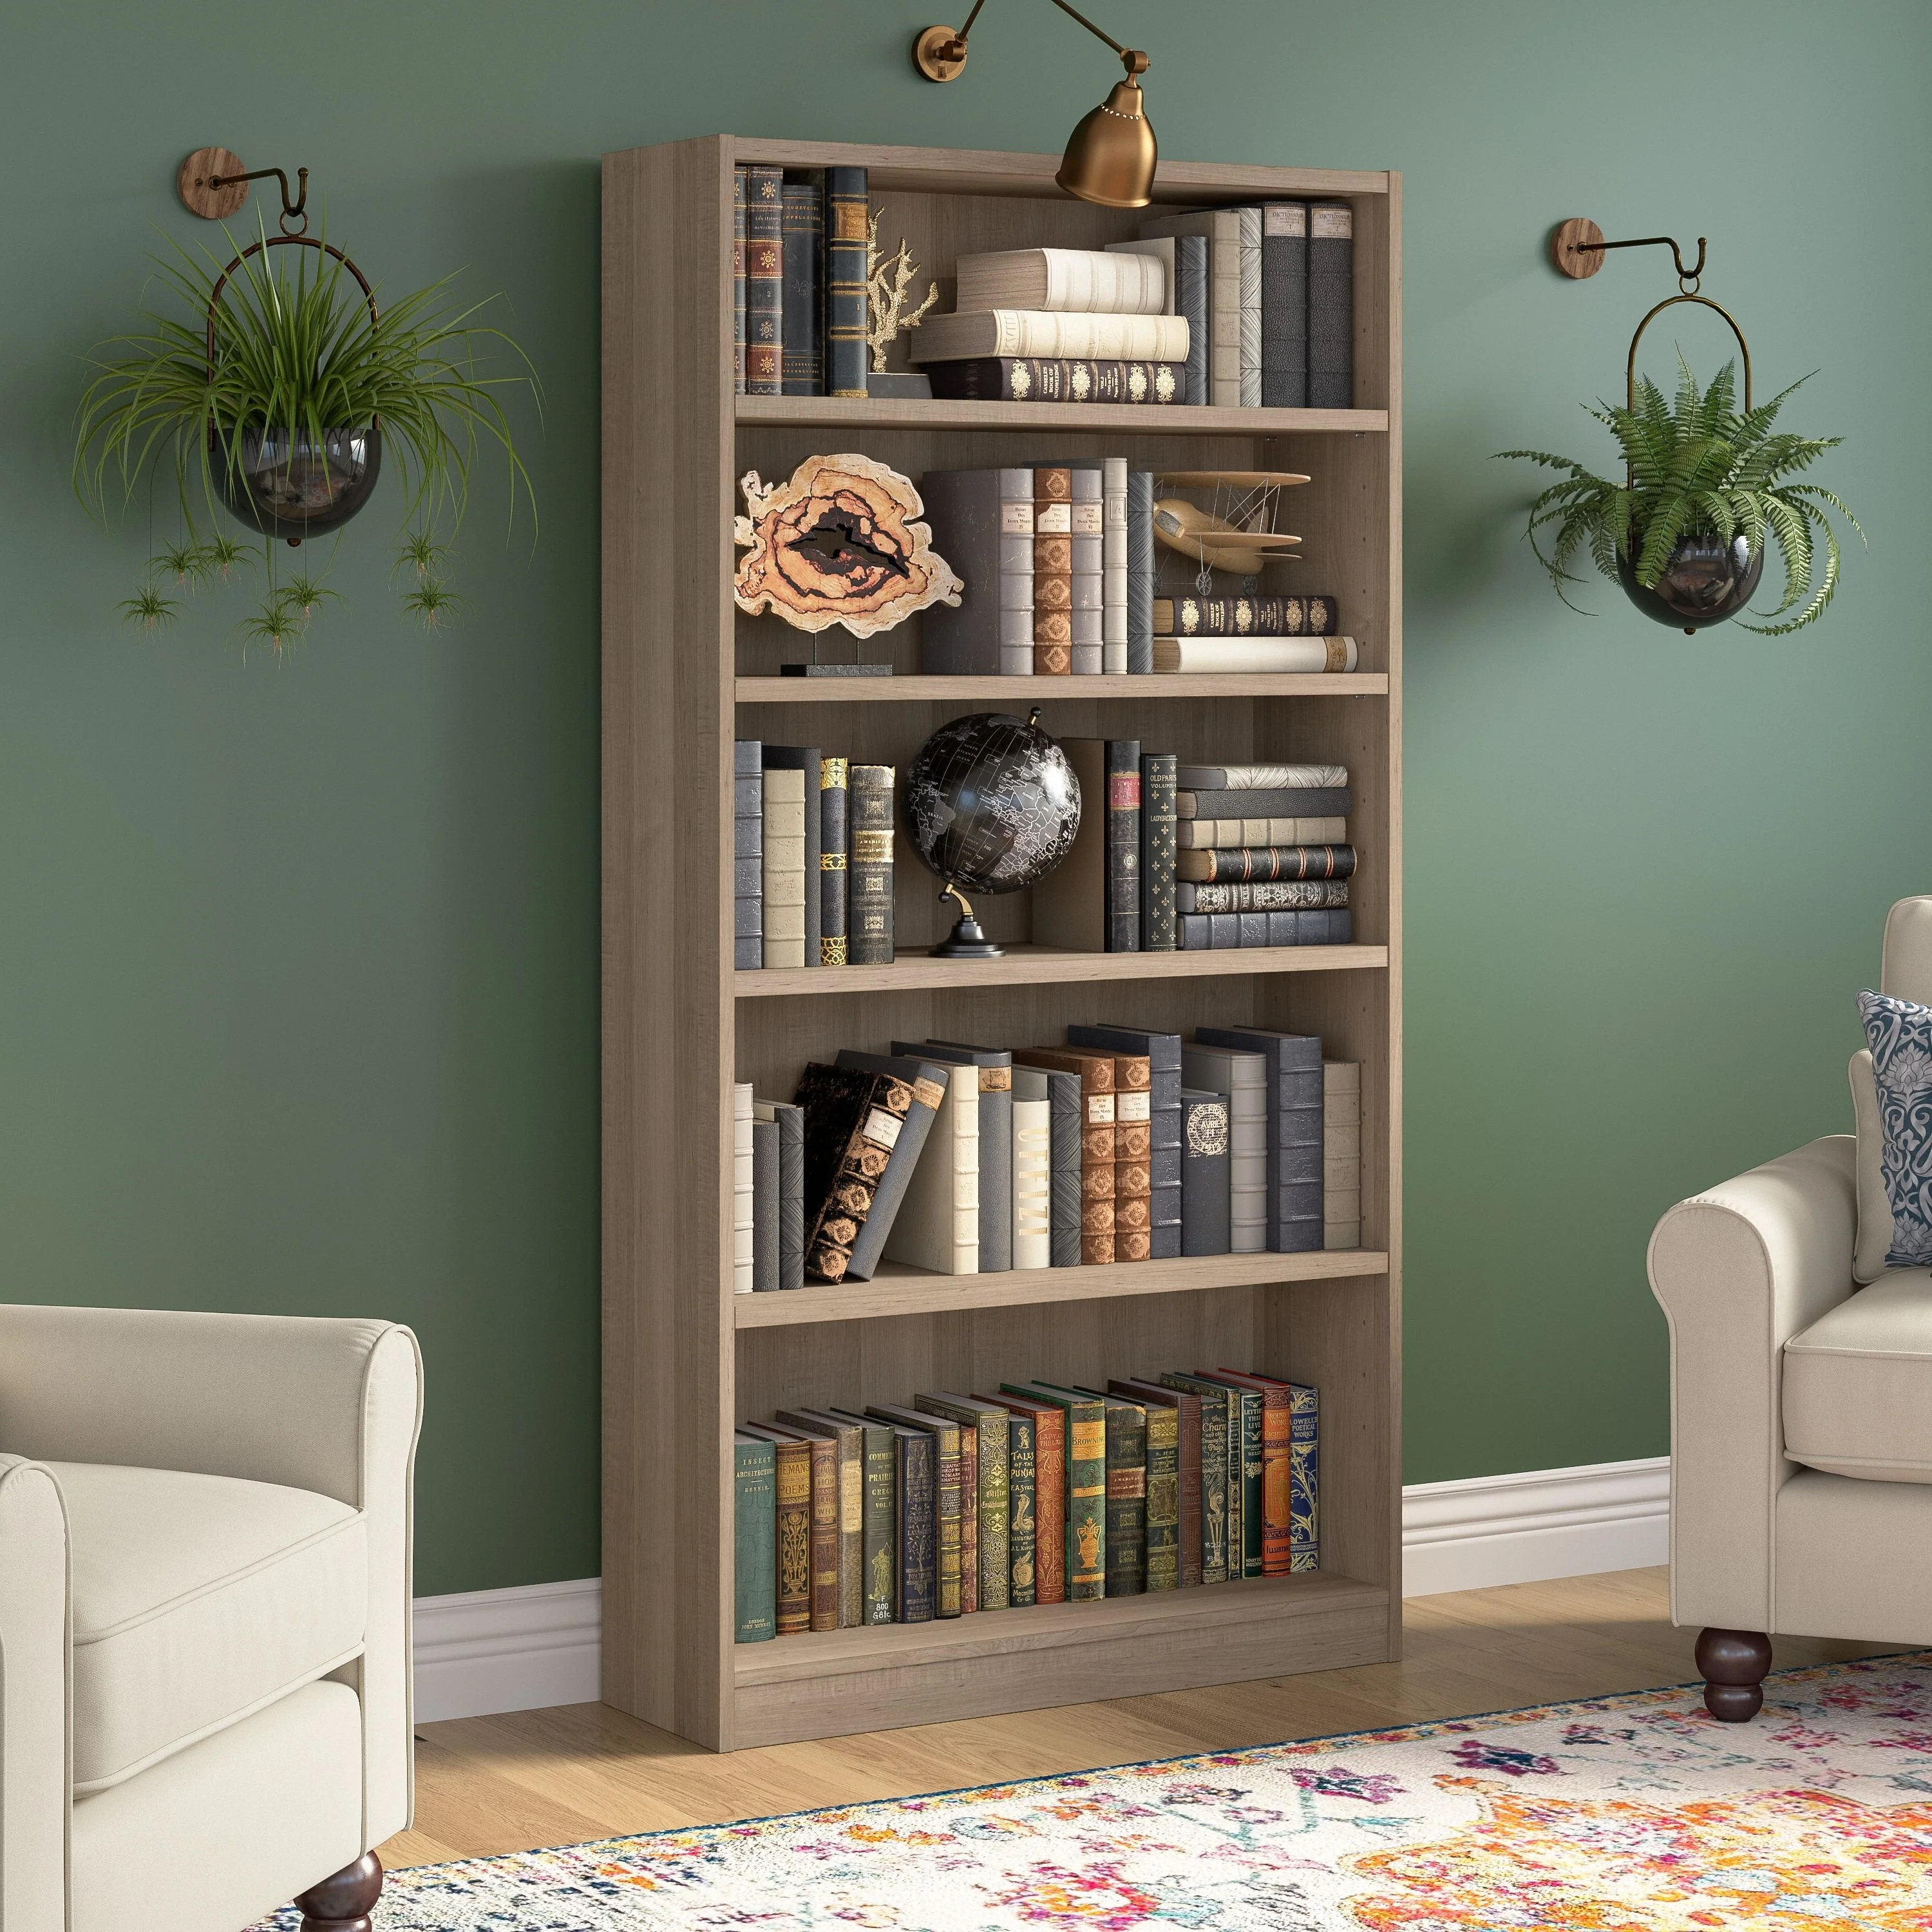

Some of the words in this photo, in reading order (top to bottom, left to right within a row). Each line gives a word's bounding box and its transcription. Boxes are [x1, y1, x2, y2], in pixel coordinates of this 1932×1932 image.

[1215, 603, 1220, 612] OF
[927, 811, 943, 821] BRAZIL
[1188, 1105, 1205, 1133] PARIS
[1018, 1127, 1048, 1236] UFFIZI
[1265, 1411, 1287, 1420] AROUND
[1289, 1416, 1318, 1425] LOWELL'S
[1202, 1422, 1227, 1432] Charm
[1292, 1423, 1316, 1432] POETICAL
[1264, 1430, 1285, 1439] EIGHTY
[1294, 1430, 1314, 1439] WORKS
[1072, 1435, 1105, 1446] BROWNING
[1208, 1443, 1224, 1452] Plays
[869, 1452, 895, 1461] COMMERC
[1010, 1450, 1034, 1461] TALES
[743, 1456, 771, 1466] INSECT
[777, 1462, 810, 1475] HEMANS
[869, 1472, 894, 1482] PRAIRIE
[1010, 1468, 1036, 1479] PUNJAB
[817, 1477, 835, 1486] HOW
[778, 1483, 810, 1497] POEMS
[819, 1495, 835, 1504] LADY
[876, 1602, 889, 1611] 800
